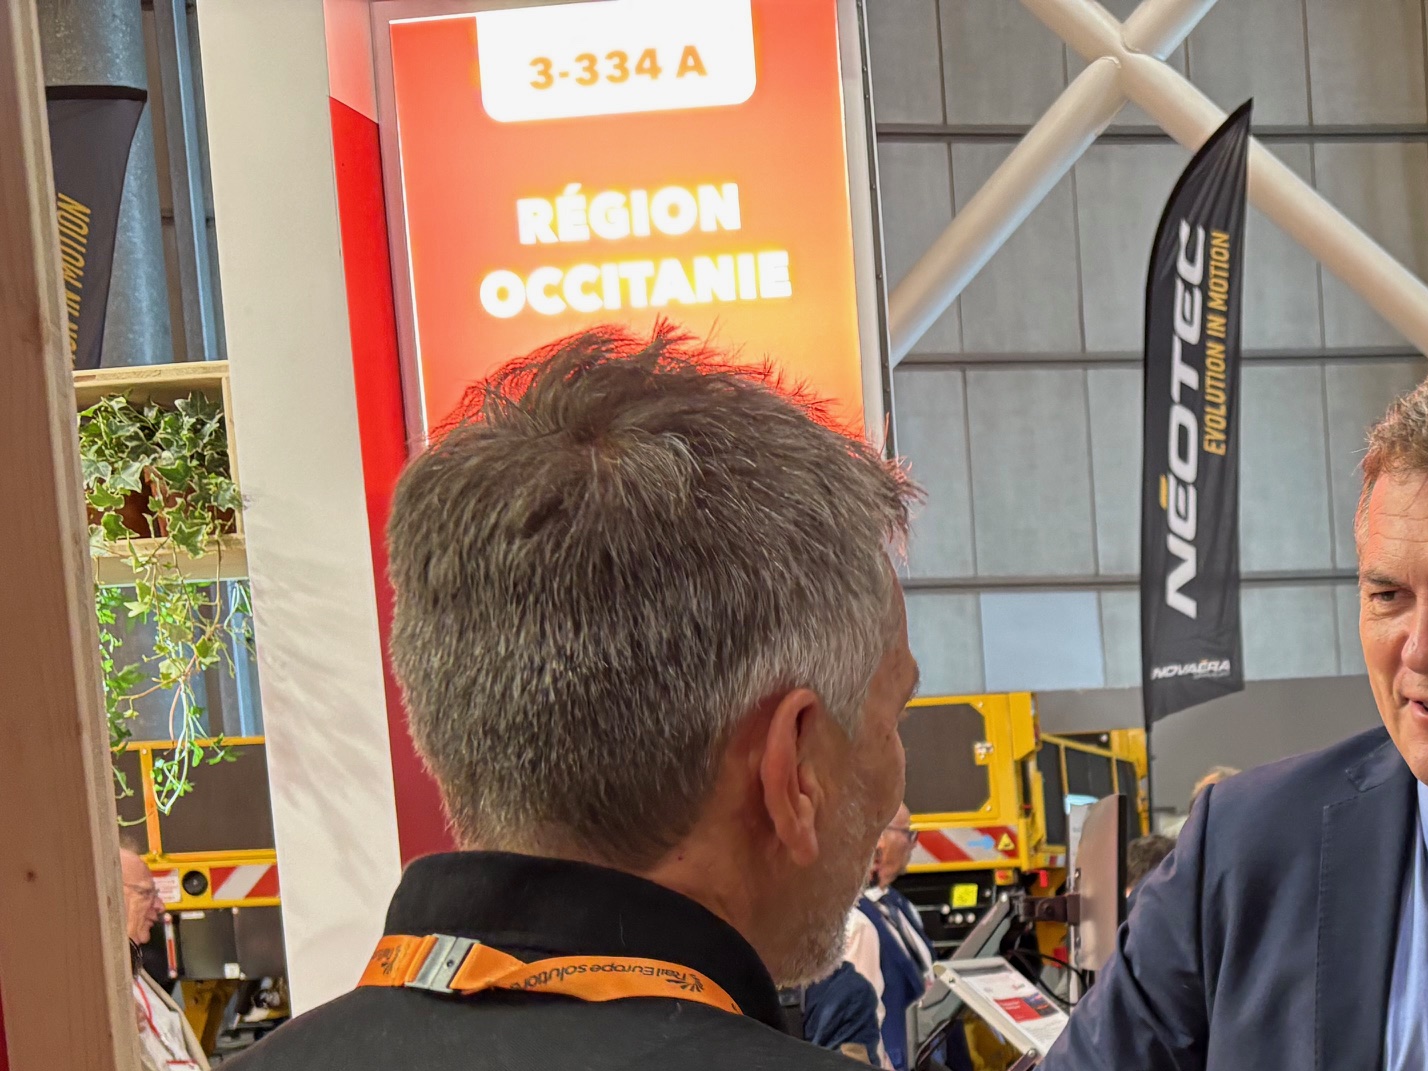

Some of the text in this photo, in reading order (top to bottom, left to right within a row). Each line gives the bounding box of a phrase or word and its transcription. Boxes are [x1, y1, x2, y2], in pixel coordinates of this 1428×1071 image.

[529, 44, 708, 90] 3-334 A
[516, 182, 742, 245] RÉGION
[479, 250, 793, 319] OCCITANIE
[1203, 229, 1231, 456] EVOLUTION IN MOTION
[1159, 218, 1206, 620] NÉOTEC
[589, 963, 655, 977] Europe
[656, 968, 687, 981] Rail
